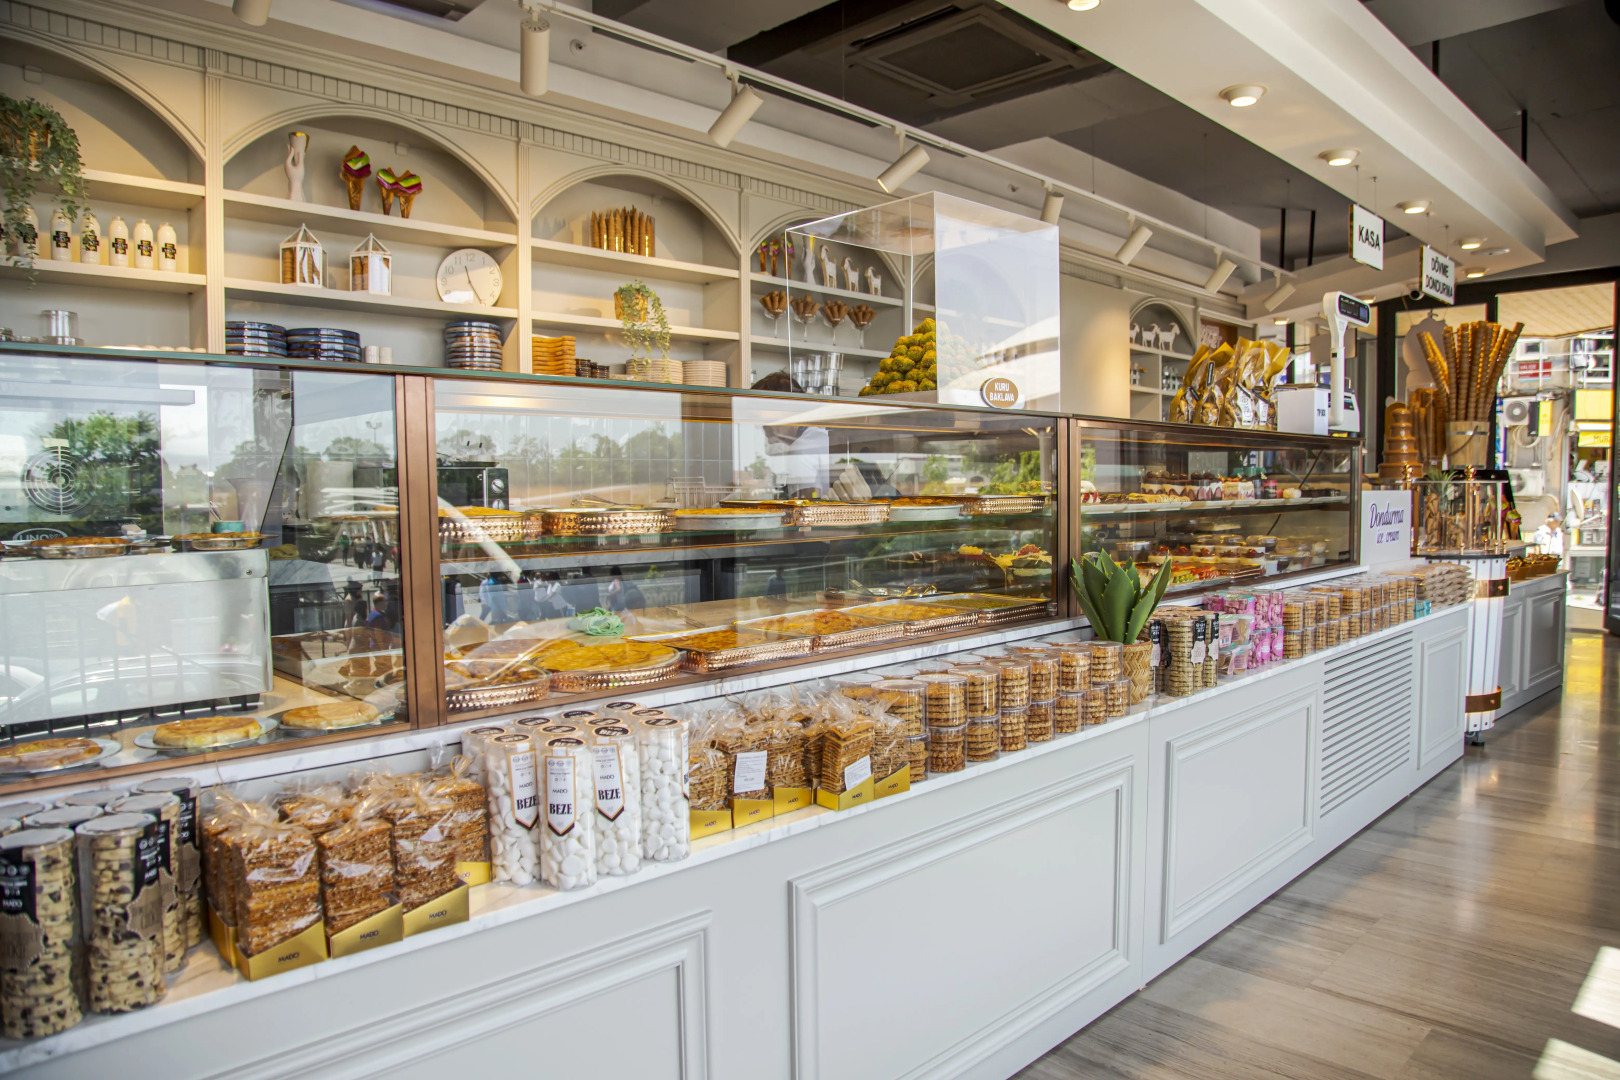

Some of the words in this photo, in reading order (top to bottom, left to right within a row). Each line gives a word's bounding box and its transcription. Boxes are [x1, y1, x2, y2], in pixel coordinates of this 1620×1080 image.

[1358, 225, 1381, 251] KASA
[465, 253, 476, 262] 12
[1431, 257, 1448, 278] DÖVME
[1426, 275, 1452, 297] DONDURMA
[994, 382, 1010, 391] KURU
[990, 392, 1014, 401] BAKLAVA
[1369, 502, 1404, 529] Dondurma
[1386, 530, 1399, 543] cream
[598, 788, 620, 801] BEZE
[516, 795, 538, 810] BEZE
[549, 803, 572, 815] BEZE
[429, 910, 447, 919] MADO
[360, 930, 379, 940] MADO
[278, 952, 299, 962] MADO
